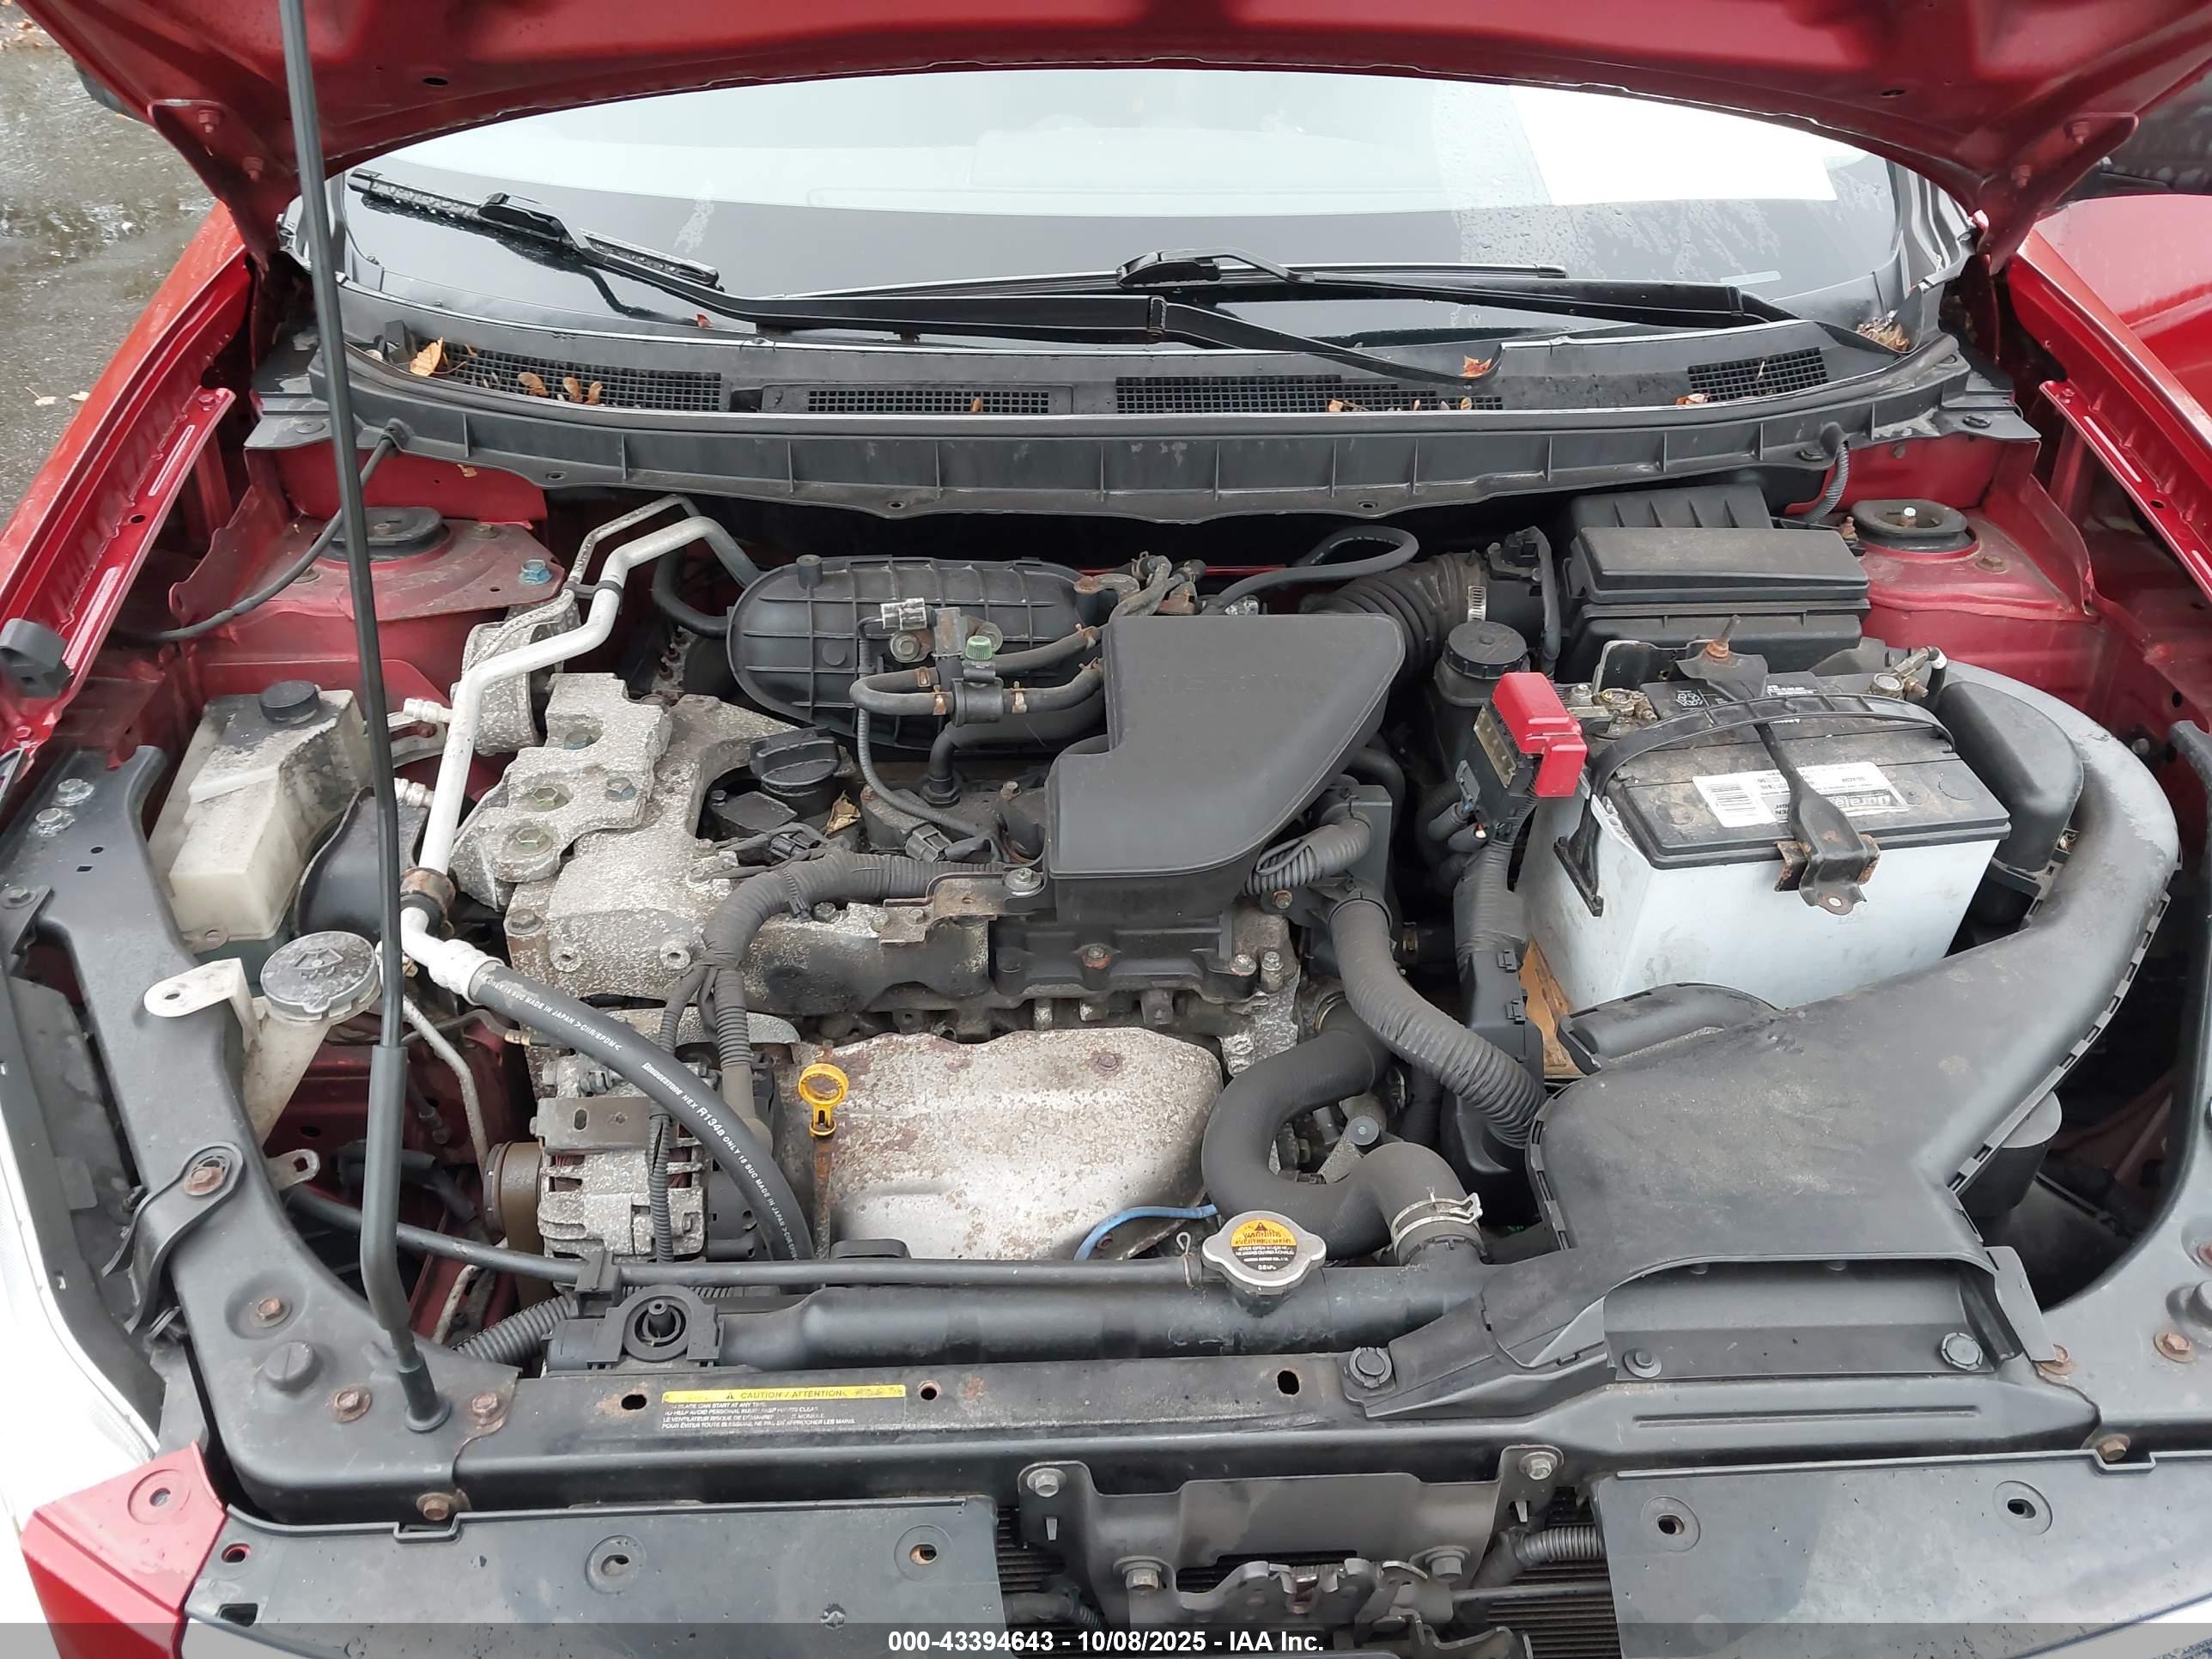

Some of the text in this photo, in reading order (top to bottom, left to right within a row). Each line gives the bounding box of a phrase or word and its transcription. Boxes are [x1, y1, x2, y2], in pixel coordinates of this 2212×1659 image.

[524, 996, 545, 1011] MADE
[544, 1004, 553, 1014] IN
[550, 1009, 574, 1025] JAPAN
[722, 1136, 741, 1155] ONLY
[755, 1178, 772, 1199] MADE
[767, 1197, 775, 1207] IN
[770, 1206, 787, 1228] JAPAN
[740, 1391, 782, 1400] CAUTION
[791, 1389, 842, 1399] ATTENTION
